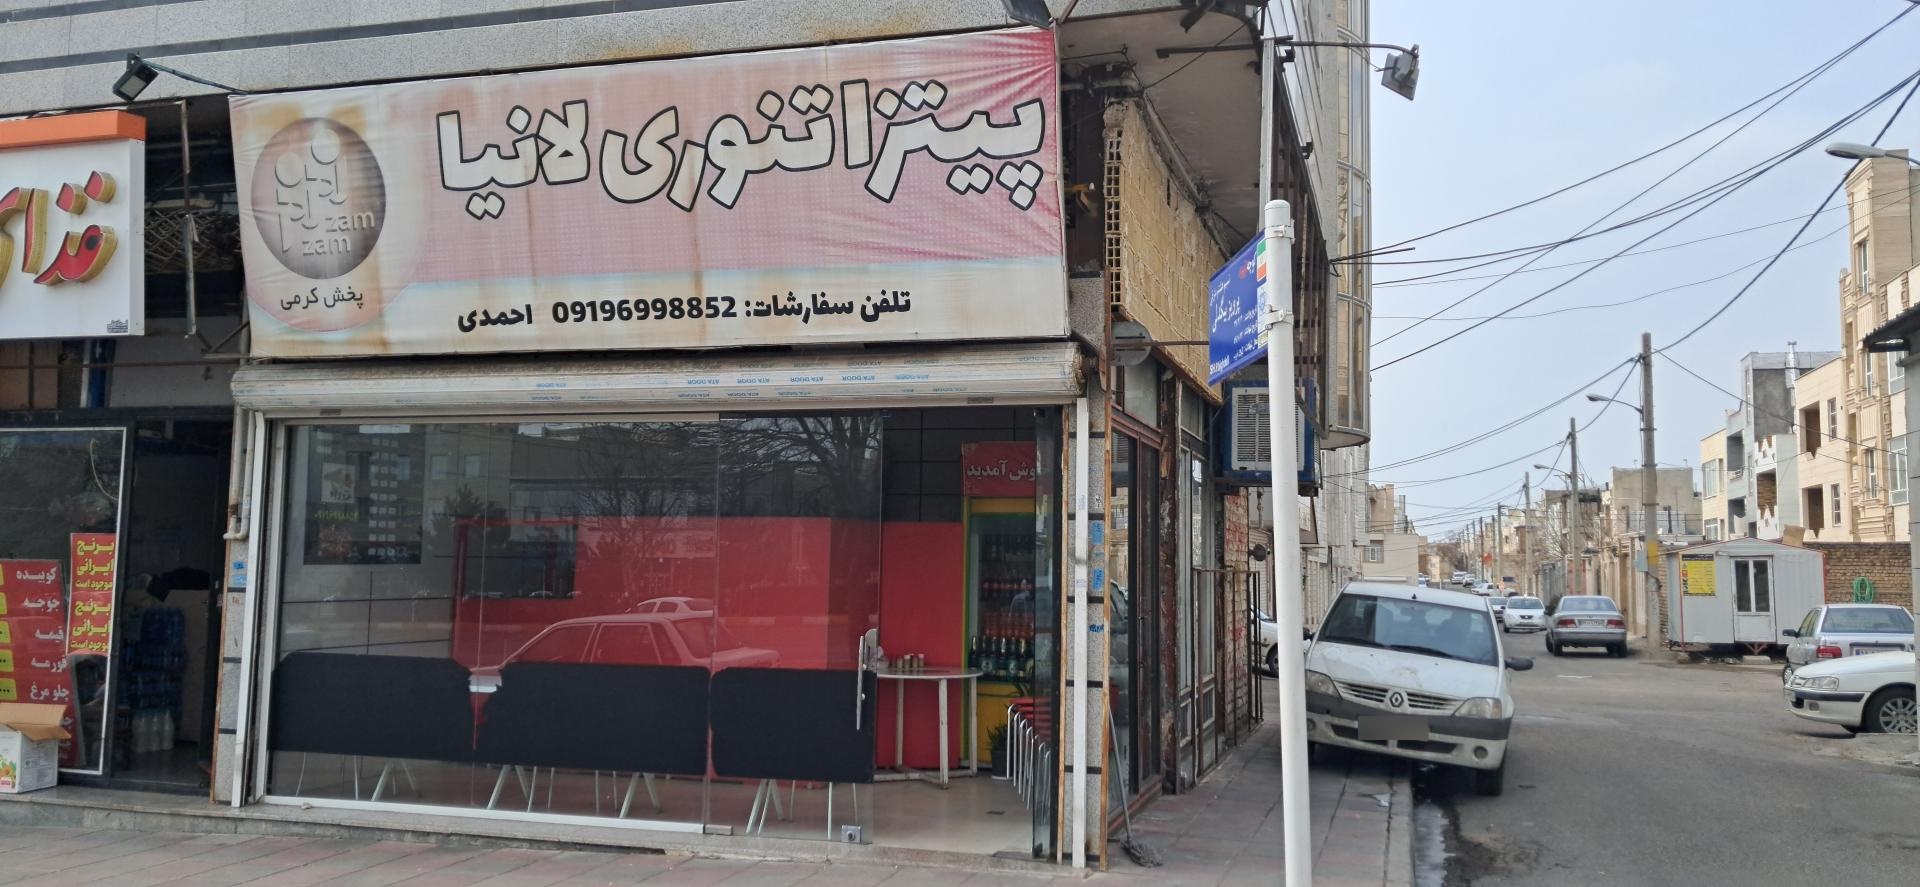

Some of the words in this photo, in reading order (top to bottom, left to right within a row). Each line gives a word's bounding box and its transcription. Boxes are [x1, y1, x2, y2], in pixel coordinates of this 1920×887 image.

[600, 84, 836, 212] تنوری
[840, 78, 1046, 211] پیتزا
[436, 99, 590, 220] لانیا
[325, 211, 375, 233] zam
[302, 236, 350, 256] zam
[281, 287, 318, 310] کرمی
[324, 286, 363, 309] پخش
[860, 291, 911, 319] تلفن
[458, 303, 533, 334] احمدی
[552, 296, 738, 325] 09196998852
[745, 292, 854, 325] سفارشات:
[967, 459, 1008, 479] آمدید
[1009, 462, 1035, 481] وش
[76, 537, 114, 556] برنج
[16, 567, 57, 584] کوبیده
[77, 559, 114, 575] ایرانی
[23, 596, 60, 614] جوجه
[74, 598, 111, 616] برنج
[35, 626, 64, 641] قیمه
[72, 619, 111, 636] ایرانی
[30, 682, 49, 700] مرغ
